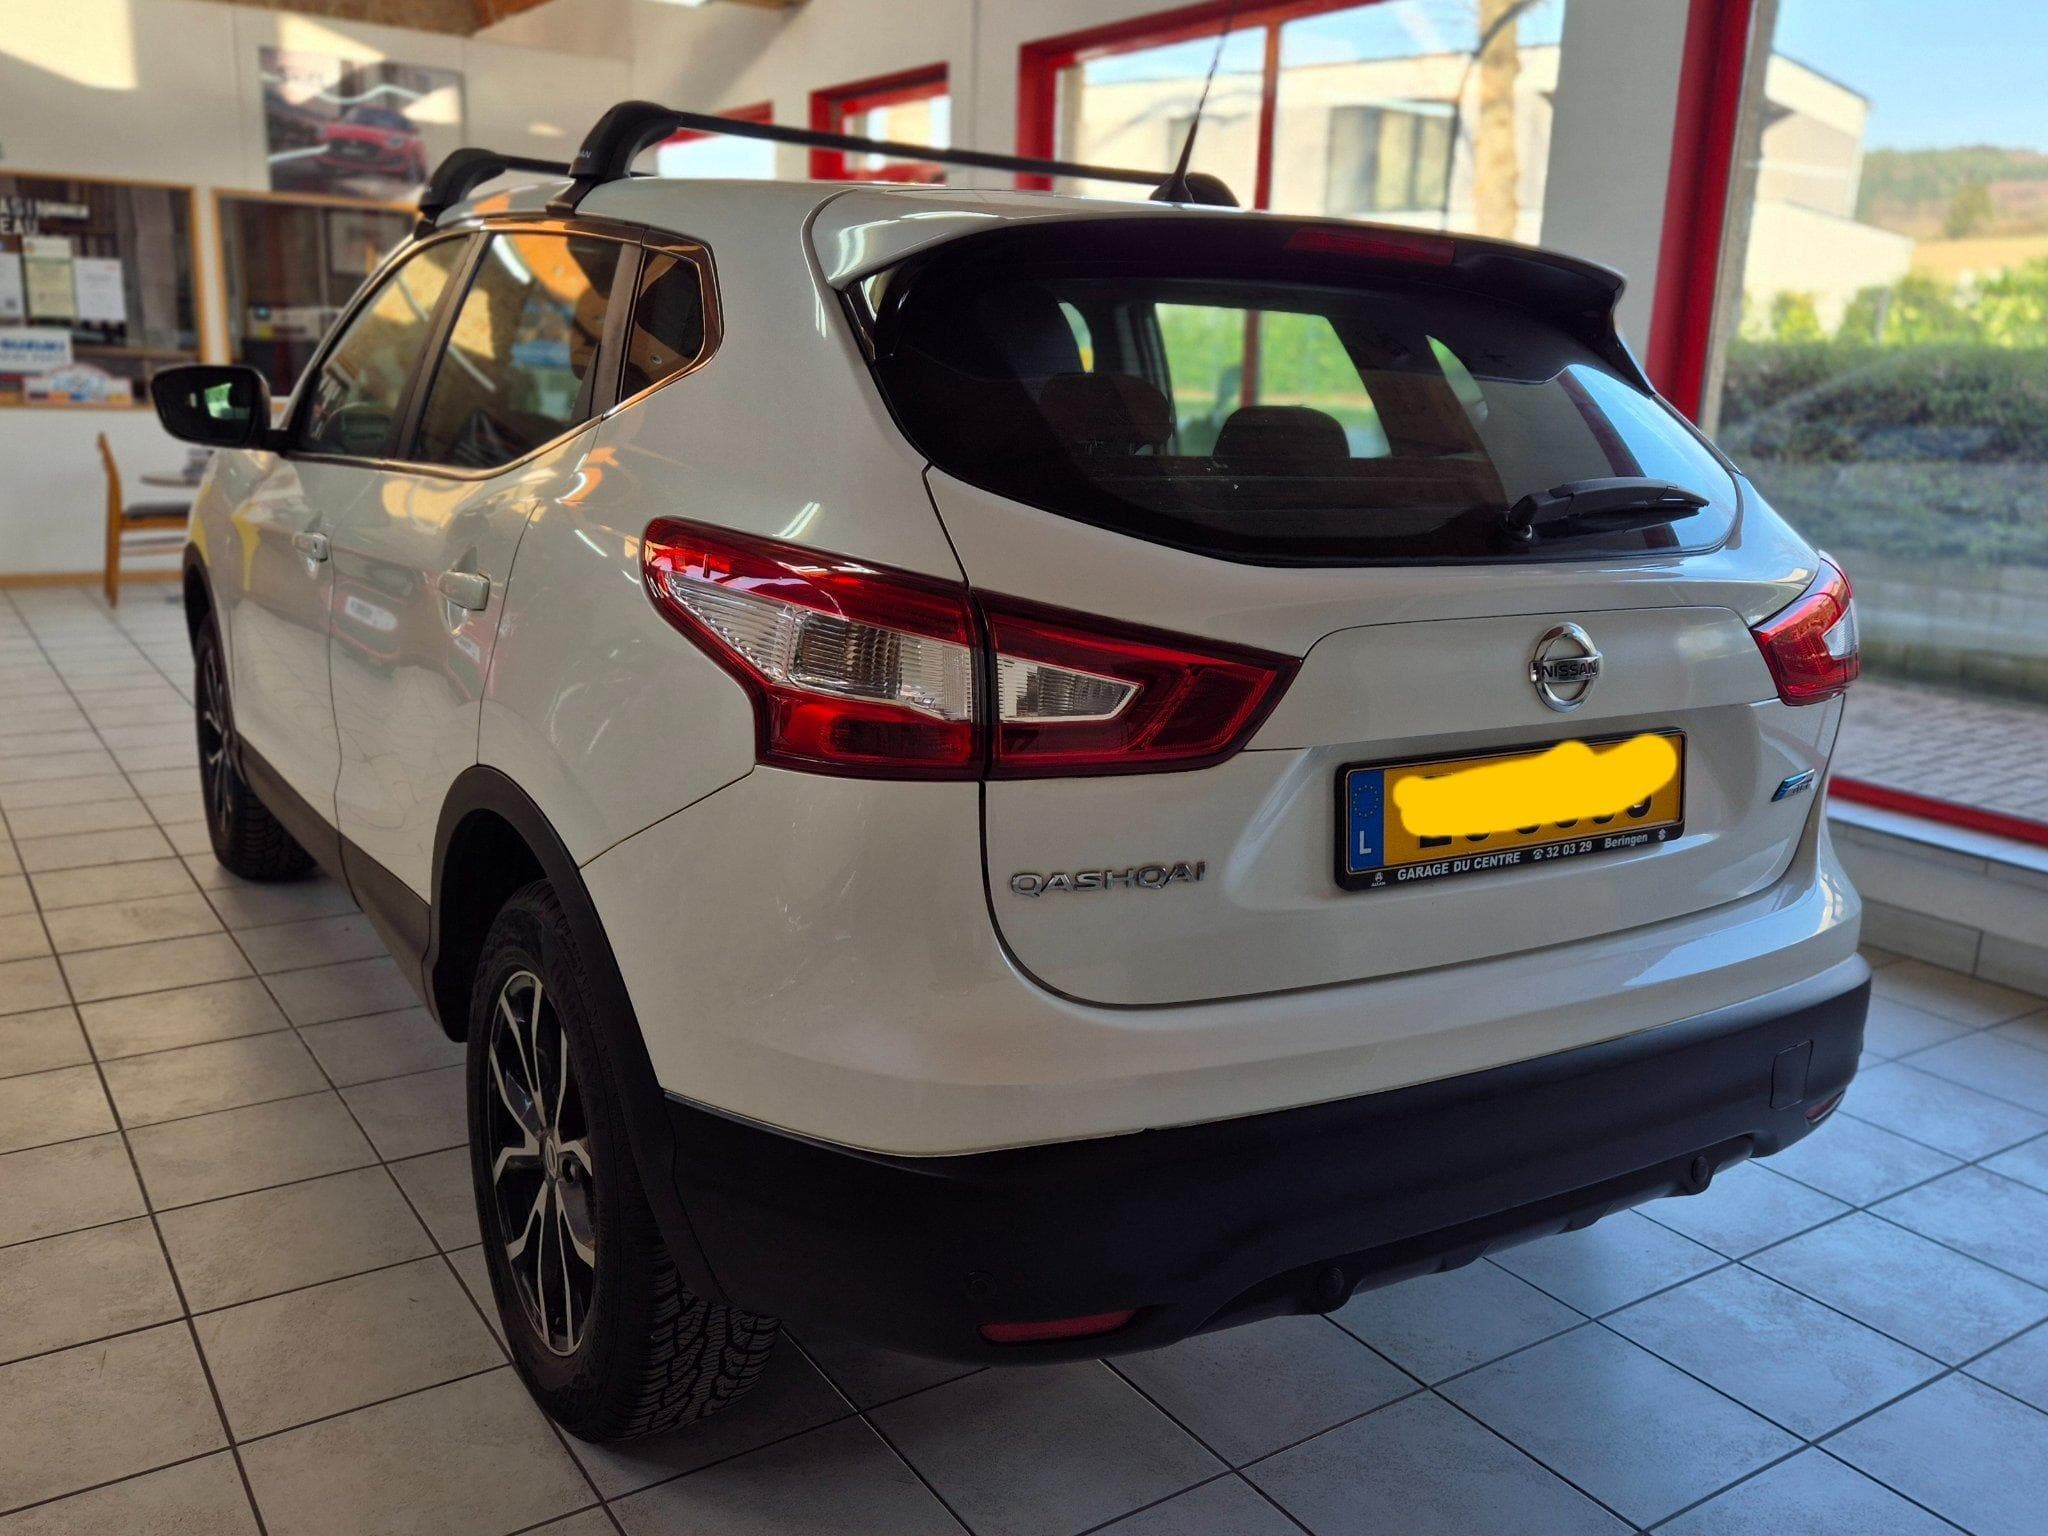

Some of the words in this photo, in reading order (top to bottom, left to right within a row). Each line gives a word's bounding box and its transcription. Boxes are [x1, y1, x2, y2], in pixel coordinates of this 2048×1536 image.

[1541, 659, 1599, 679] NISSAN
[1359, 830, 1372, 855] L
[1397, 862, 1449, 880] GARAGE
[1453, 858, 1470, 873] DU
[1473, 852, 1521, 869] CENTRE
[1546, 845, 1559, 858] 32
[1562, 843, 1576, 855] 03
[1579, 840, 1592, 853] 29
[1604, 833, 1648, 849] Beringen
[1010, 861, 1206, 898] QASHQAI
